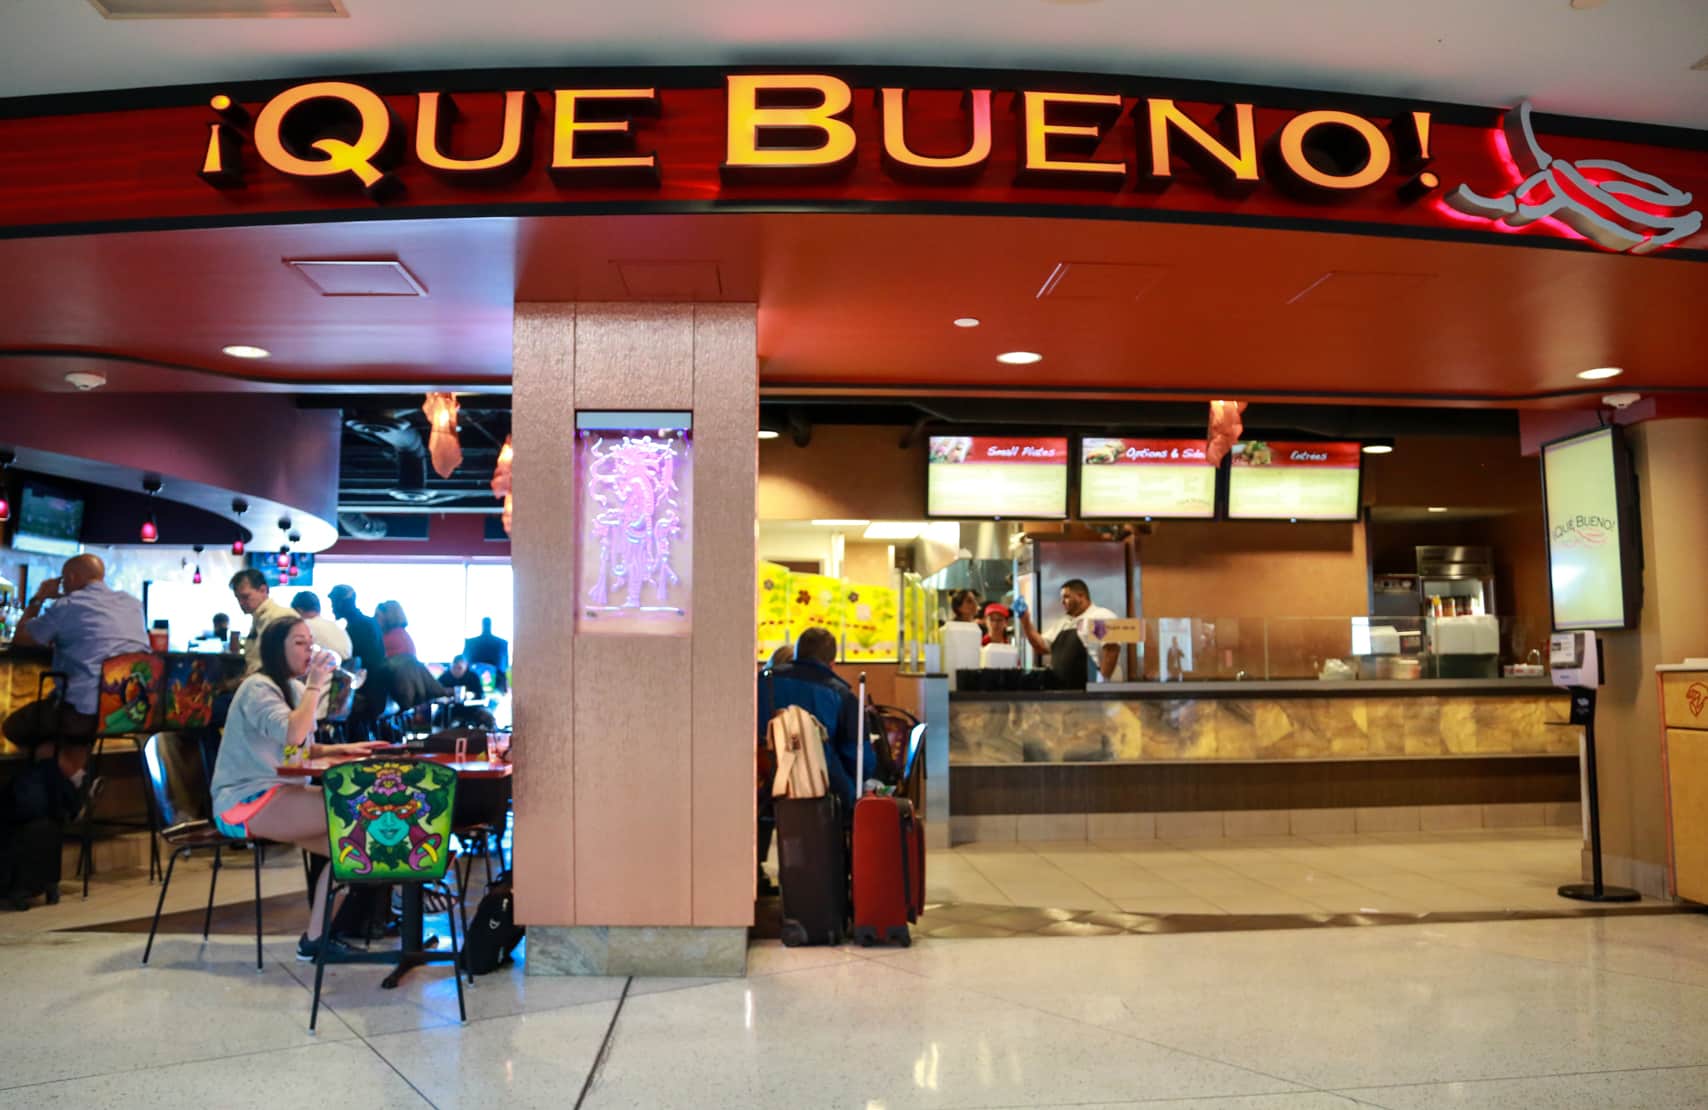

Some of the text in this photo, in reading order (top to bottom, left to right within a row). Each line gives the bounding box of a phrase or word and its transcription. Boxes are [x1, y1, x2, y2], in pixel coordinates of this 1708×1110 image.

[202, 73, 1440, 189] ¡QUE BUENO!
[1126, 447, 1168, 461] Options
